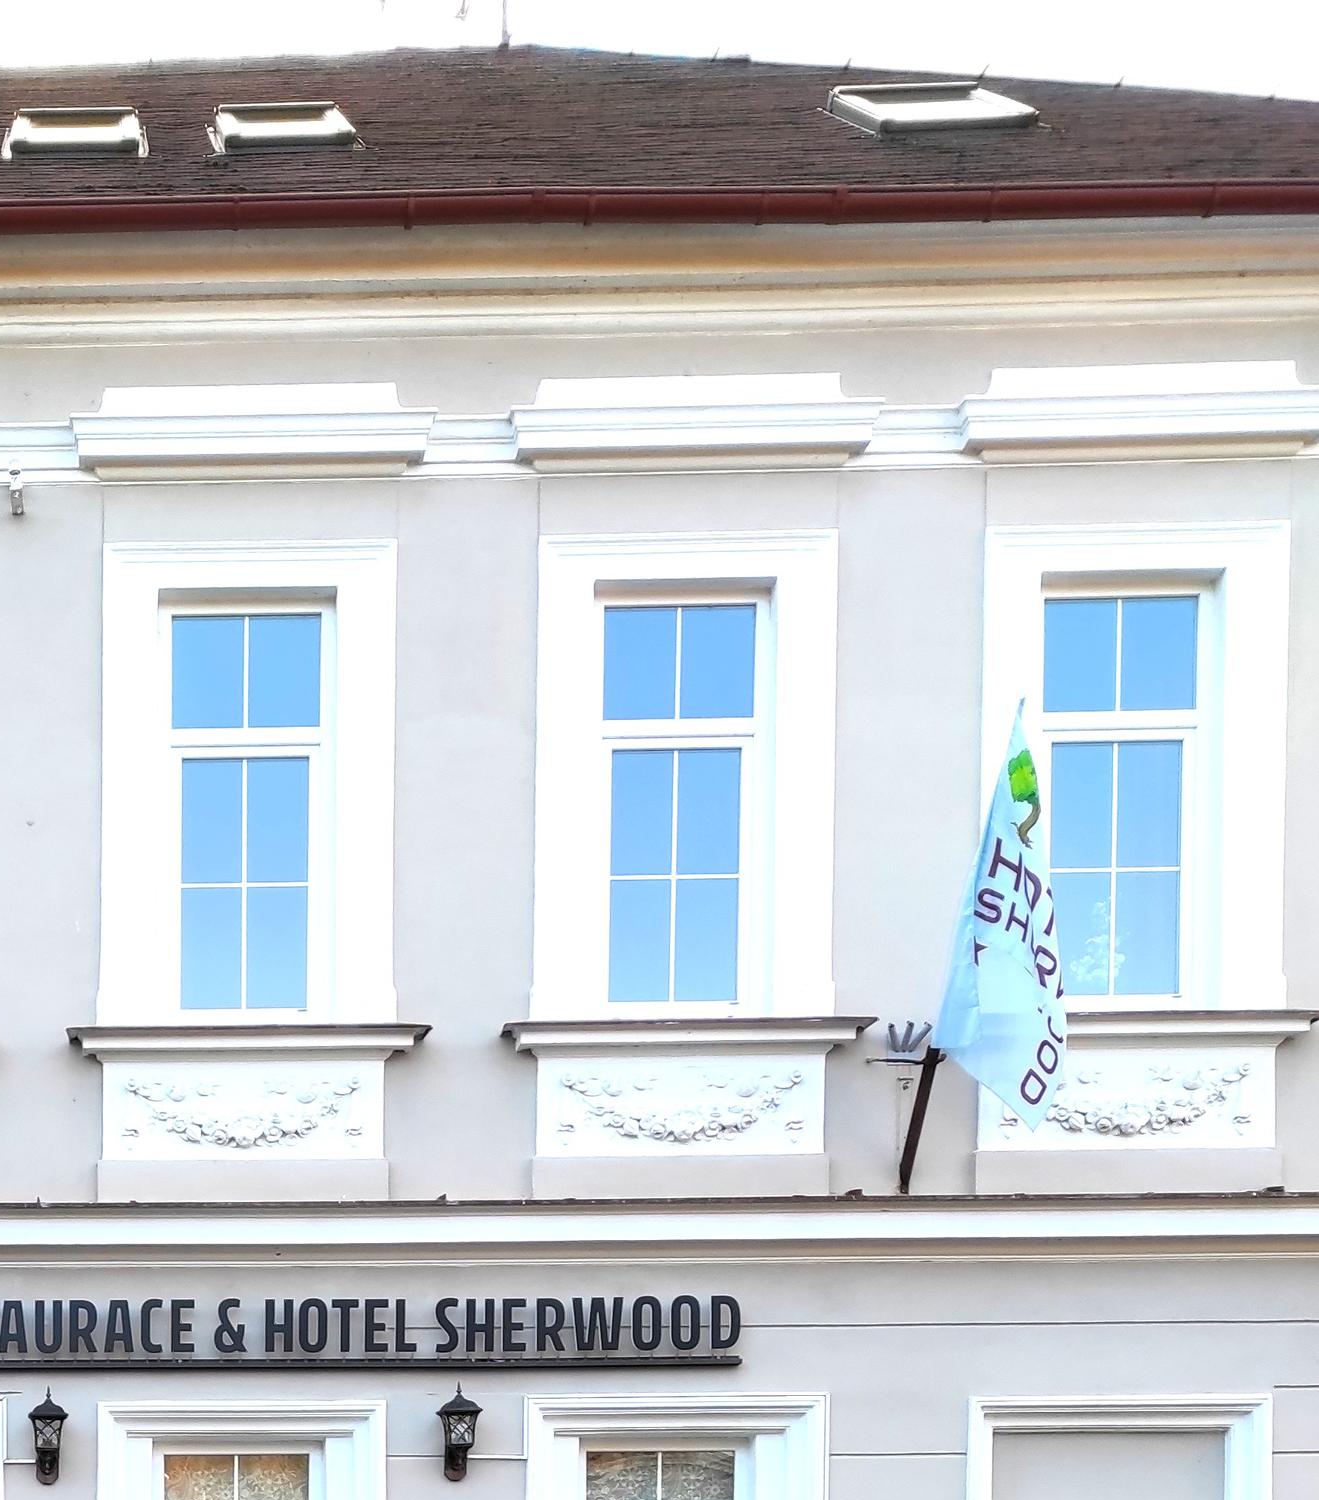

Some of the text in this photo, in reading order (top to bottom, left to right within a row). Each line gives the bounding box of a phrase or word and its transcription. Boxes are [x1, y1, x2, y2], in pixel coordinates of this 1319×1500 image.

[213, 1298, 247, 1353] &
[264, 1297, 417, 1353] HOTEL
[435, 1295, 742, 1352] SHERWOOD
